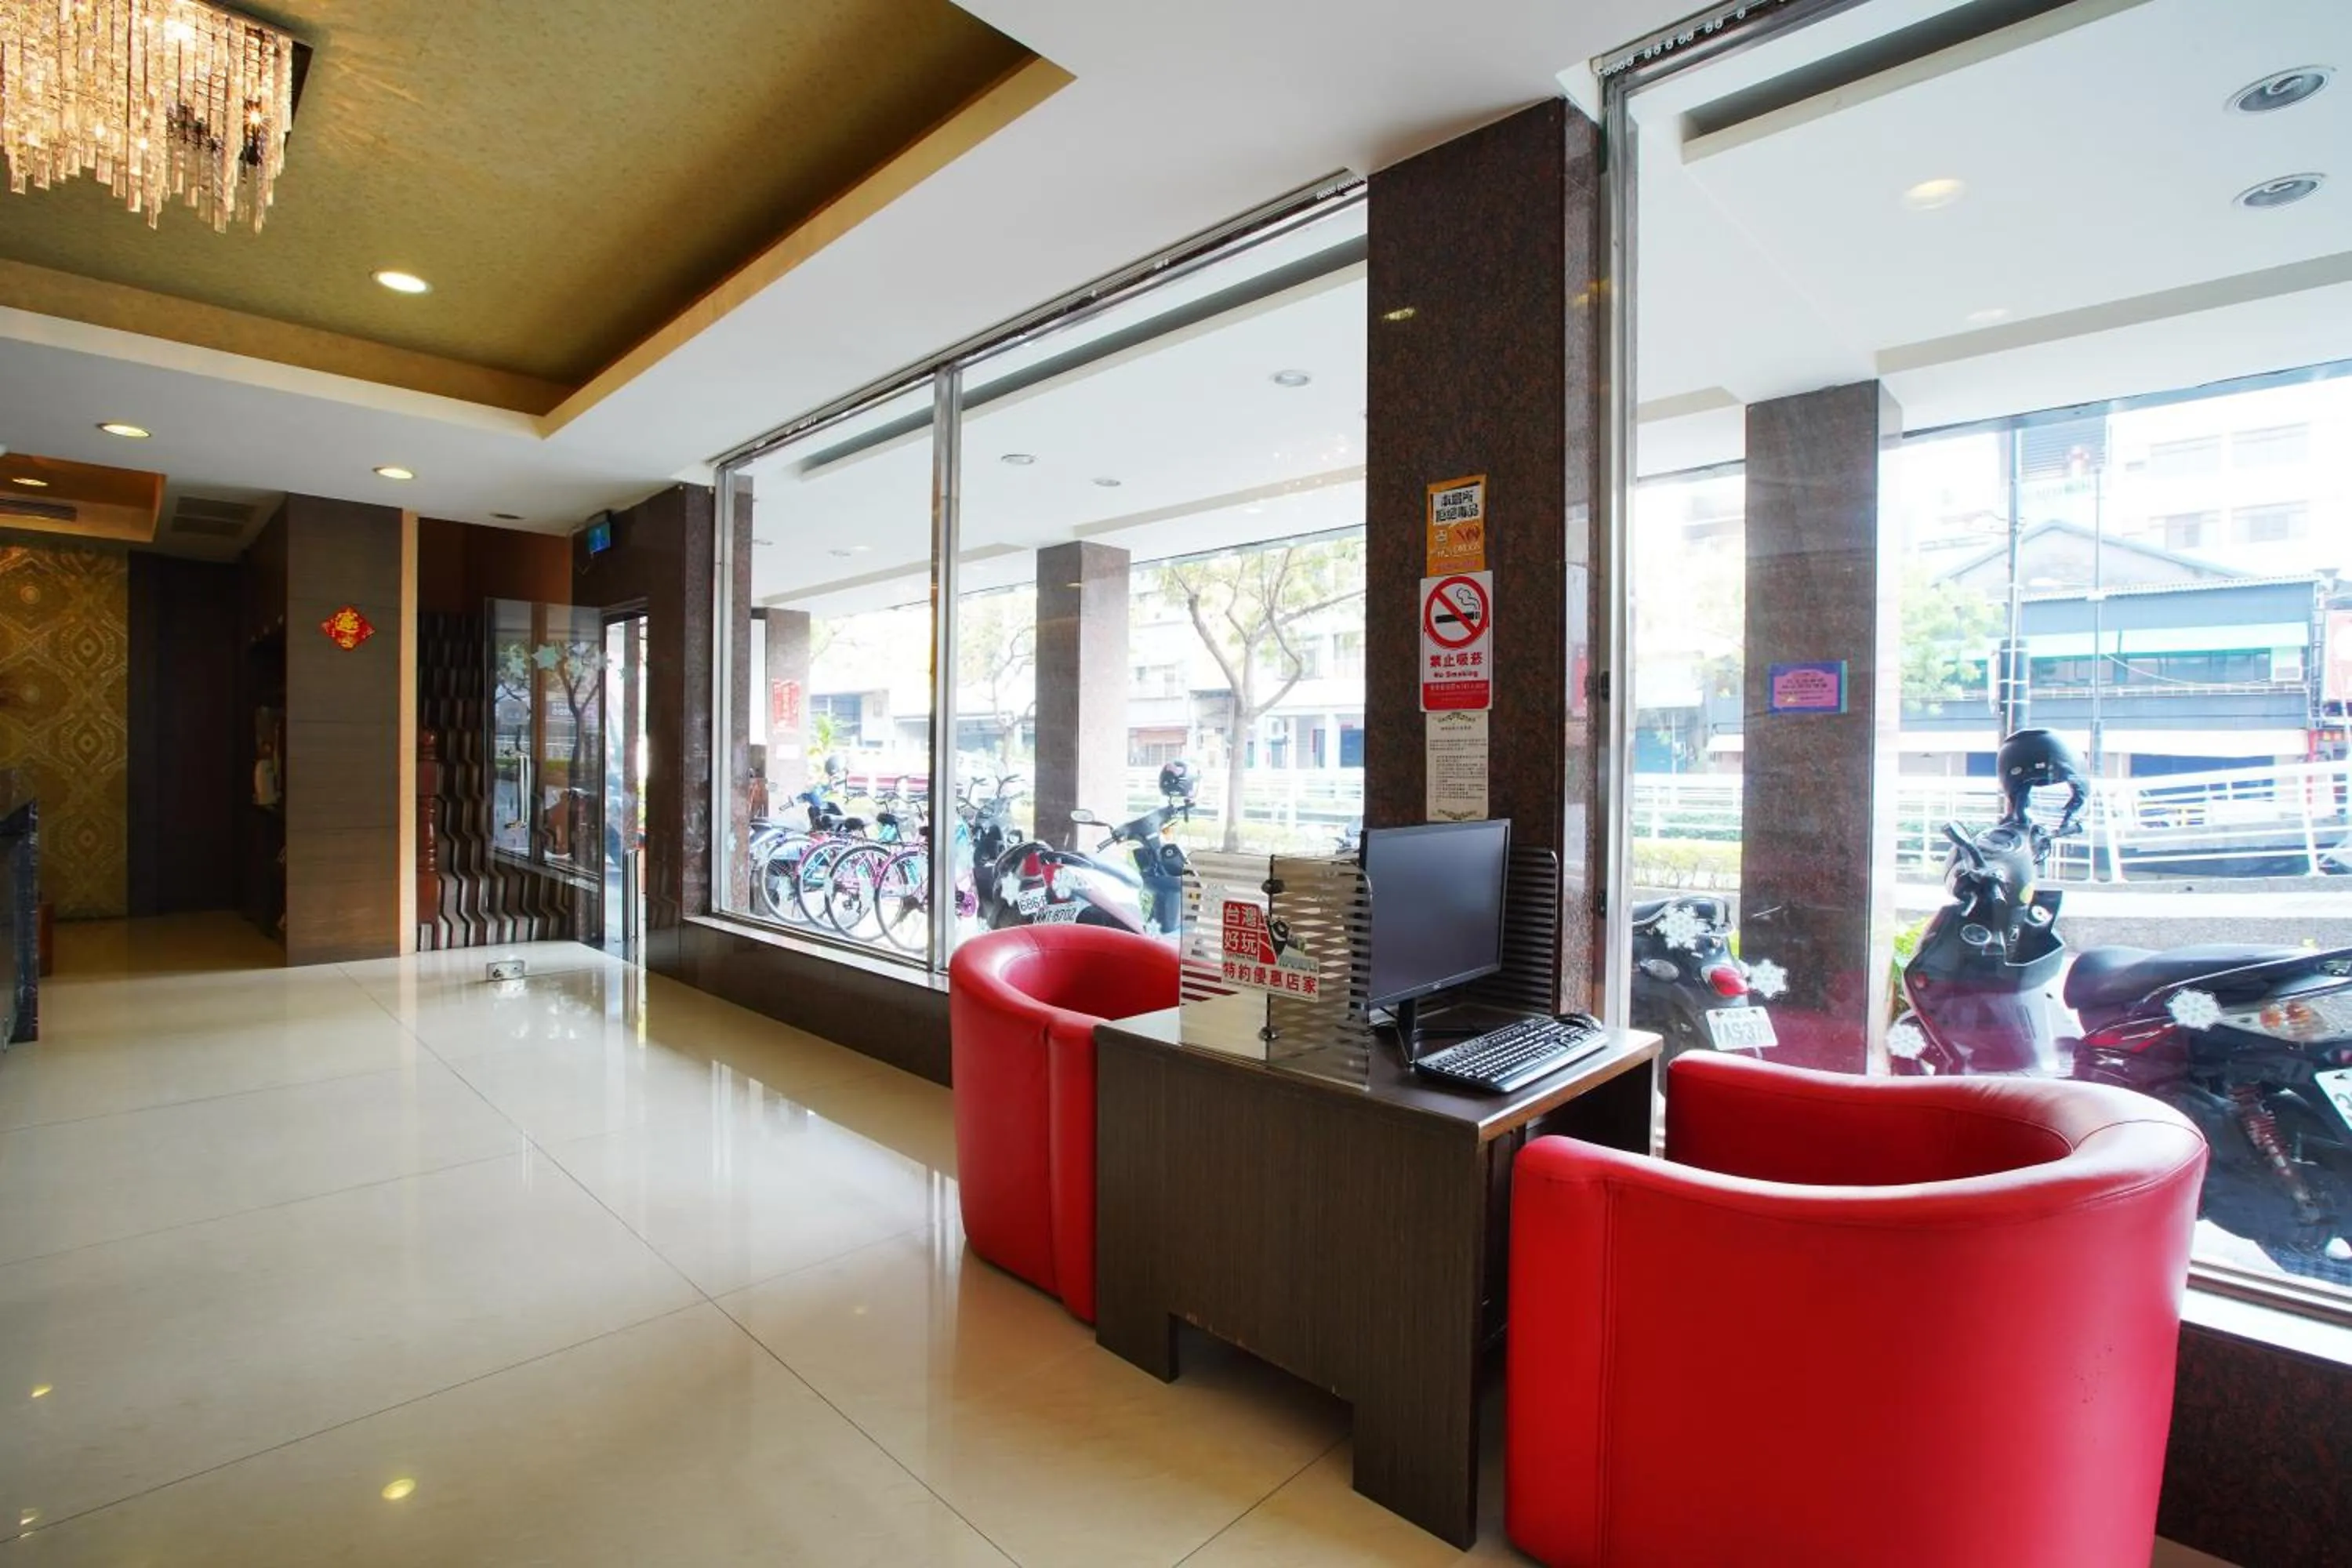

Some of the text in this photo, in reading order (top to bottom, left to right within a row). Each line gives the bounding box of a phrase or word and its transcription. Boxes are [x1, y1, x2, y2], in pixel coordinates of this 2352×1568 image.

[1430, 652, 1483, 667] 禁止吸菸
[1225, 904, 1258, 928] 台灣
[1224, 929, 1258, 954] 好玩
[1222, 960, 1317, 994] 特約優惠店家
